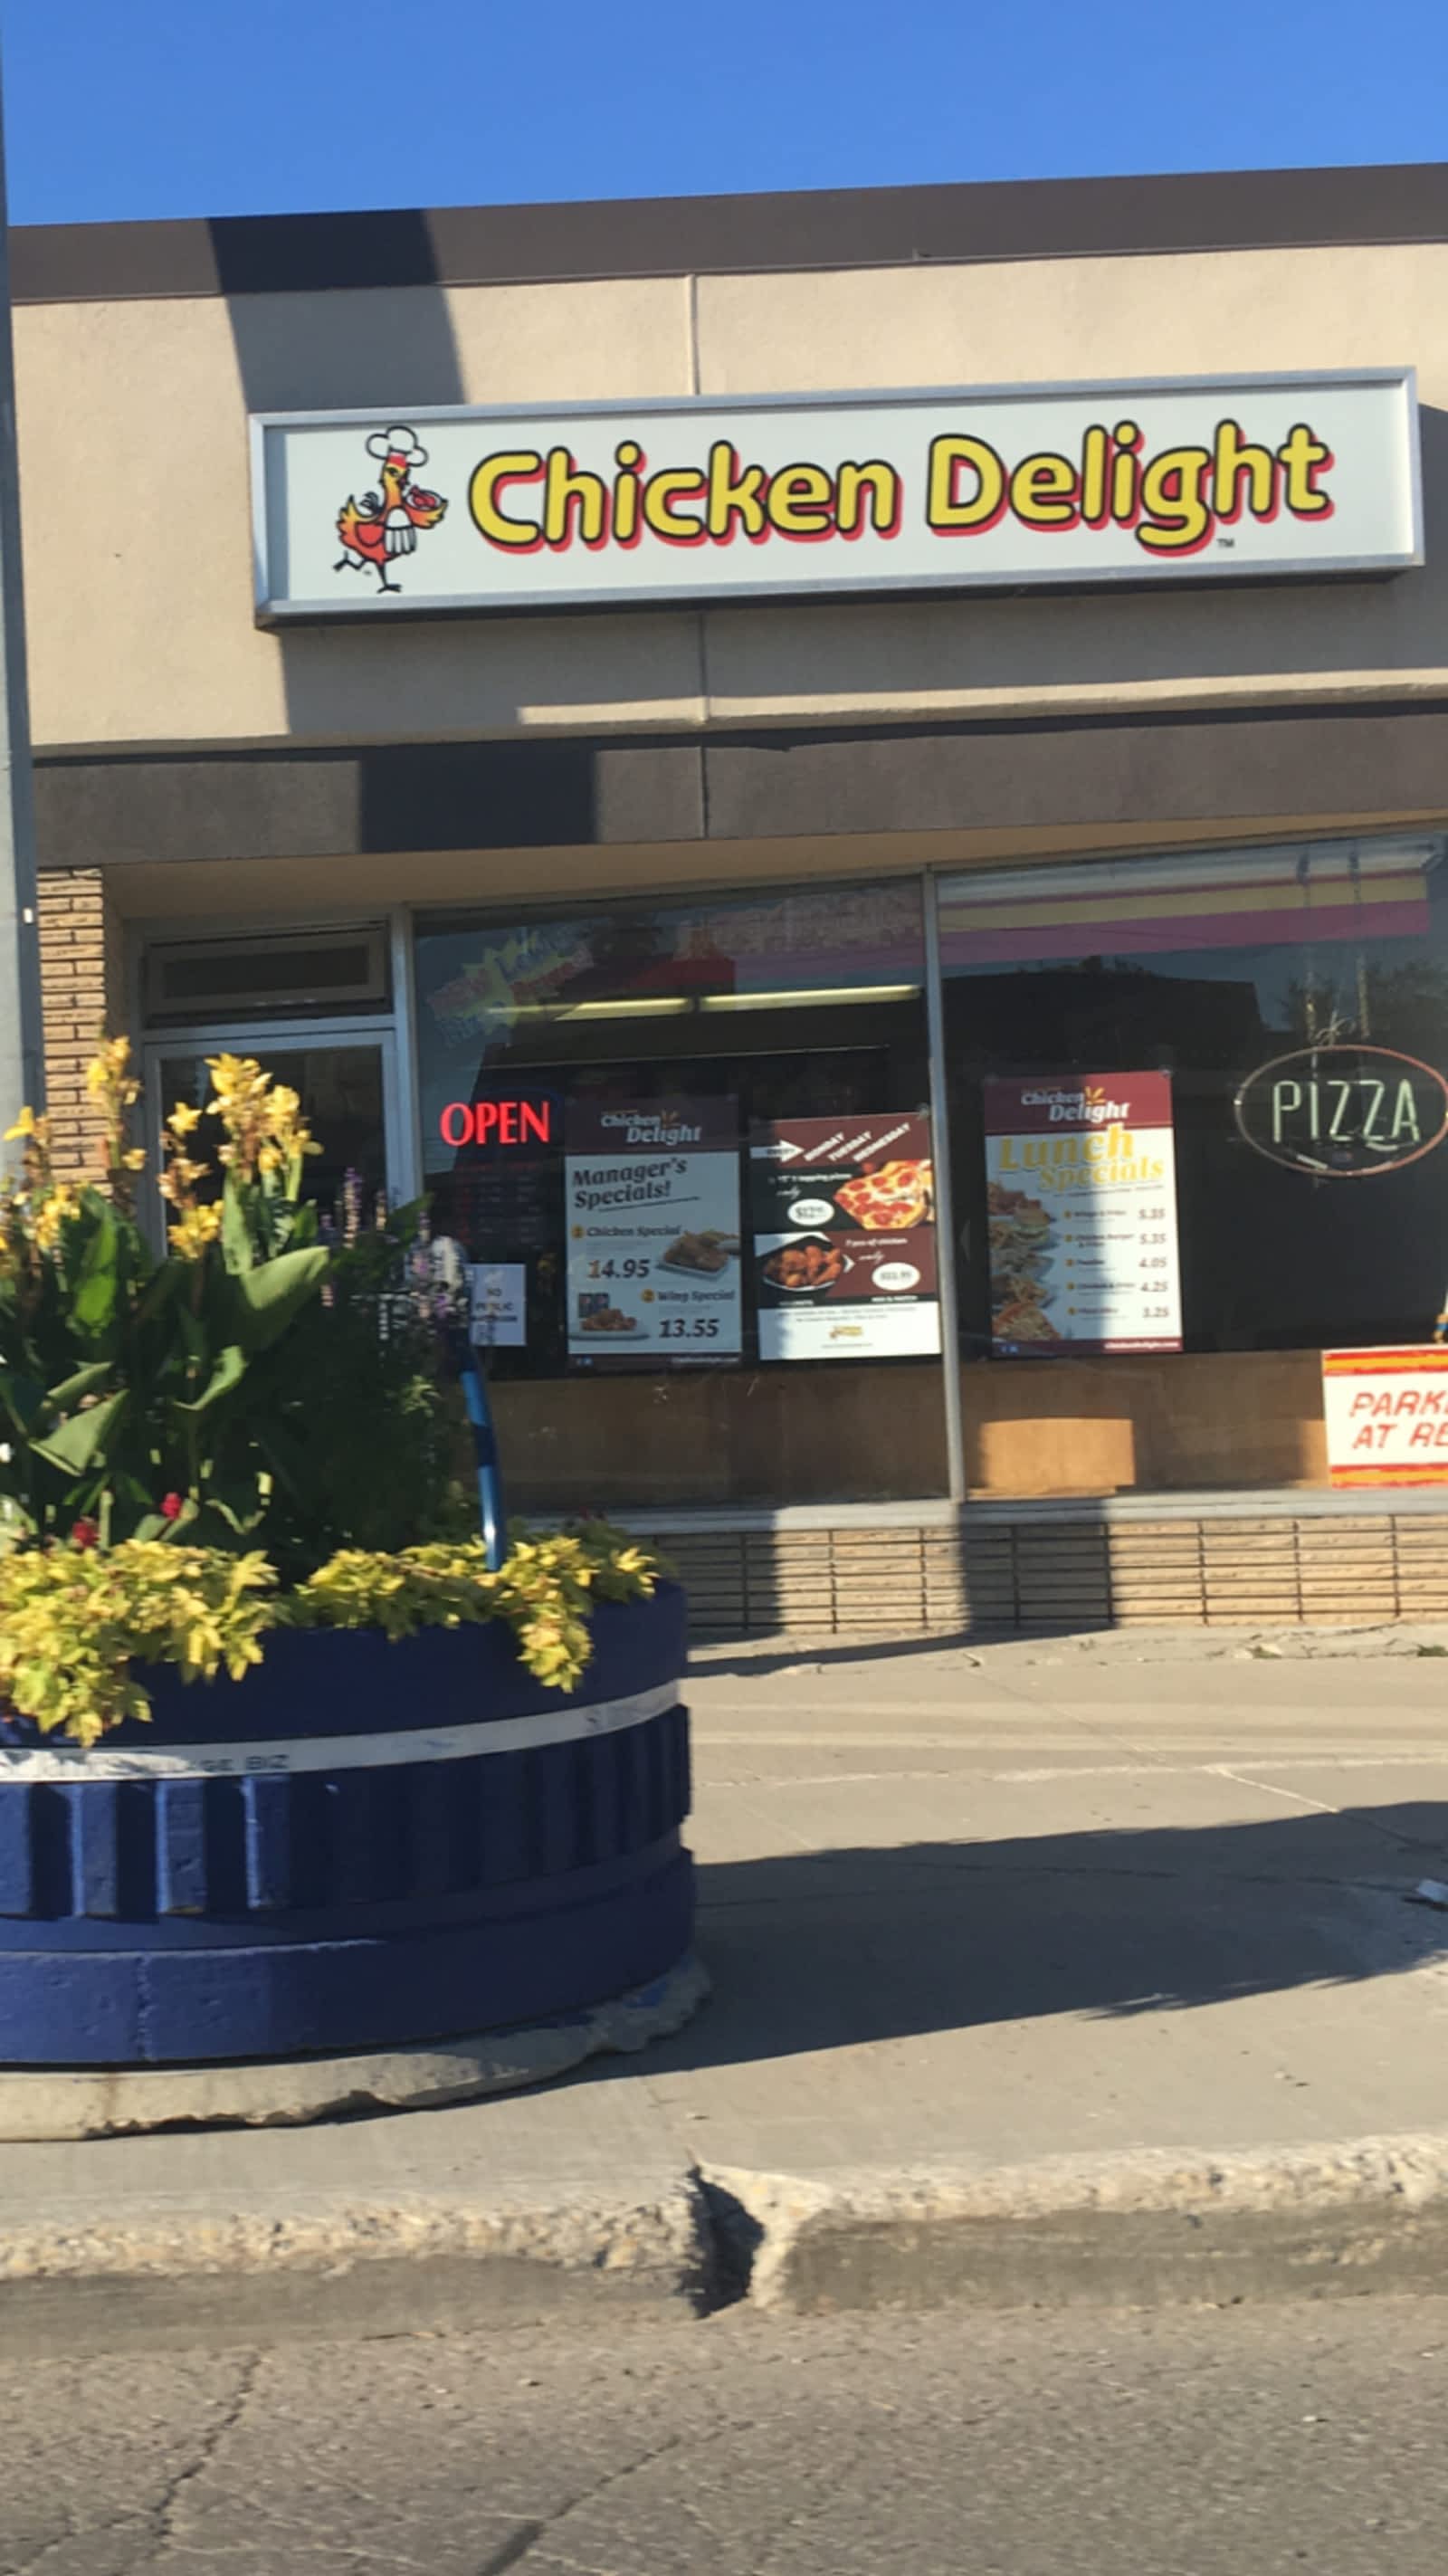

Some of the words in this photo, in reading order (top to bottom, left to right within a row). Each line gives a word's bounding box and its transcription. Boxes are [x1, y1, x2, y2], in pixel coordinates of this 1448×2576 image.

[469, 440, 902, 554] Chicken
[926, 419, 1335, 558] Delight
[1021, 1091, 1085, 1105] Chicken
[1273, 1079, 1420, 1143] PIZZA
[440, 1101, 550, 1147] OPEN
[600, 1113, 662, 1128] Chicken
[1048, 1101, 1131, 1123] Delight
[625, 1124, 702, 1146] Delight
[999, 1122, 1134, 1171] Lunch
[572, 1157, 688, 1187] Manager's
[1041, 1155, 1165, 1192] Specials
[574, 1180, 672, 1210] Specials!
[586, 1226, 634, 1236] Chicken
[636, 1224, 681, 1238] Special
[587, 1259, 650, 1279] 14.95
[658, 1291, 689, 1302] Wing
[691, 1289, 736, 1302] Special
[659, 1319, 719, 1339] 13.55
[1349, 1389, 1448, 1417] PARK
[1352, 1424, 1397, 1450] AT
